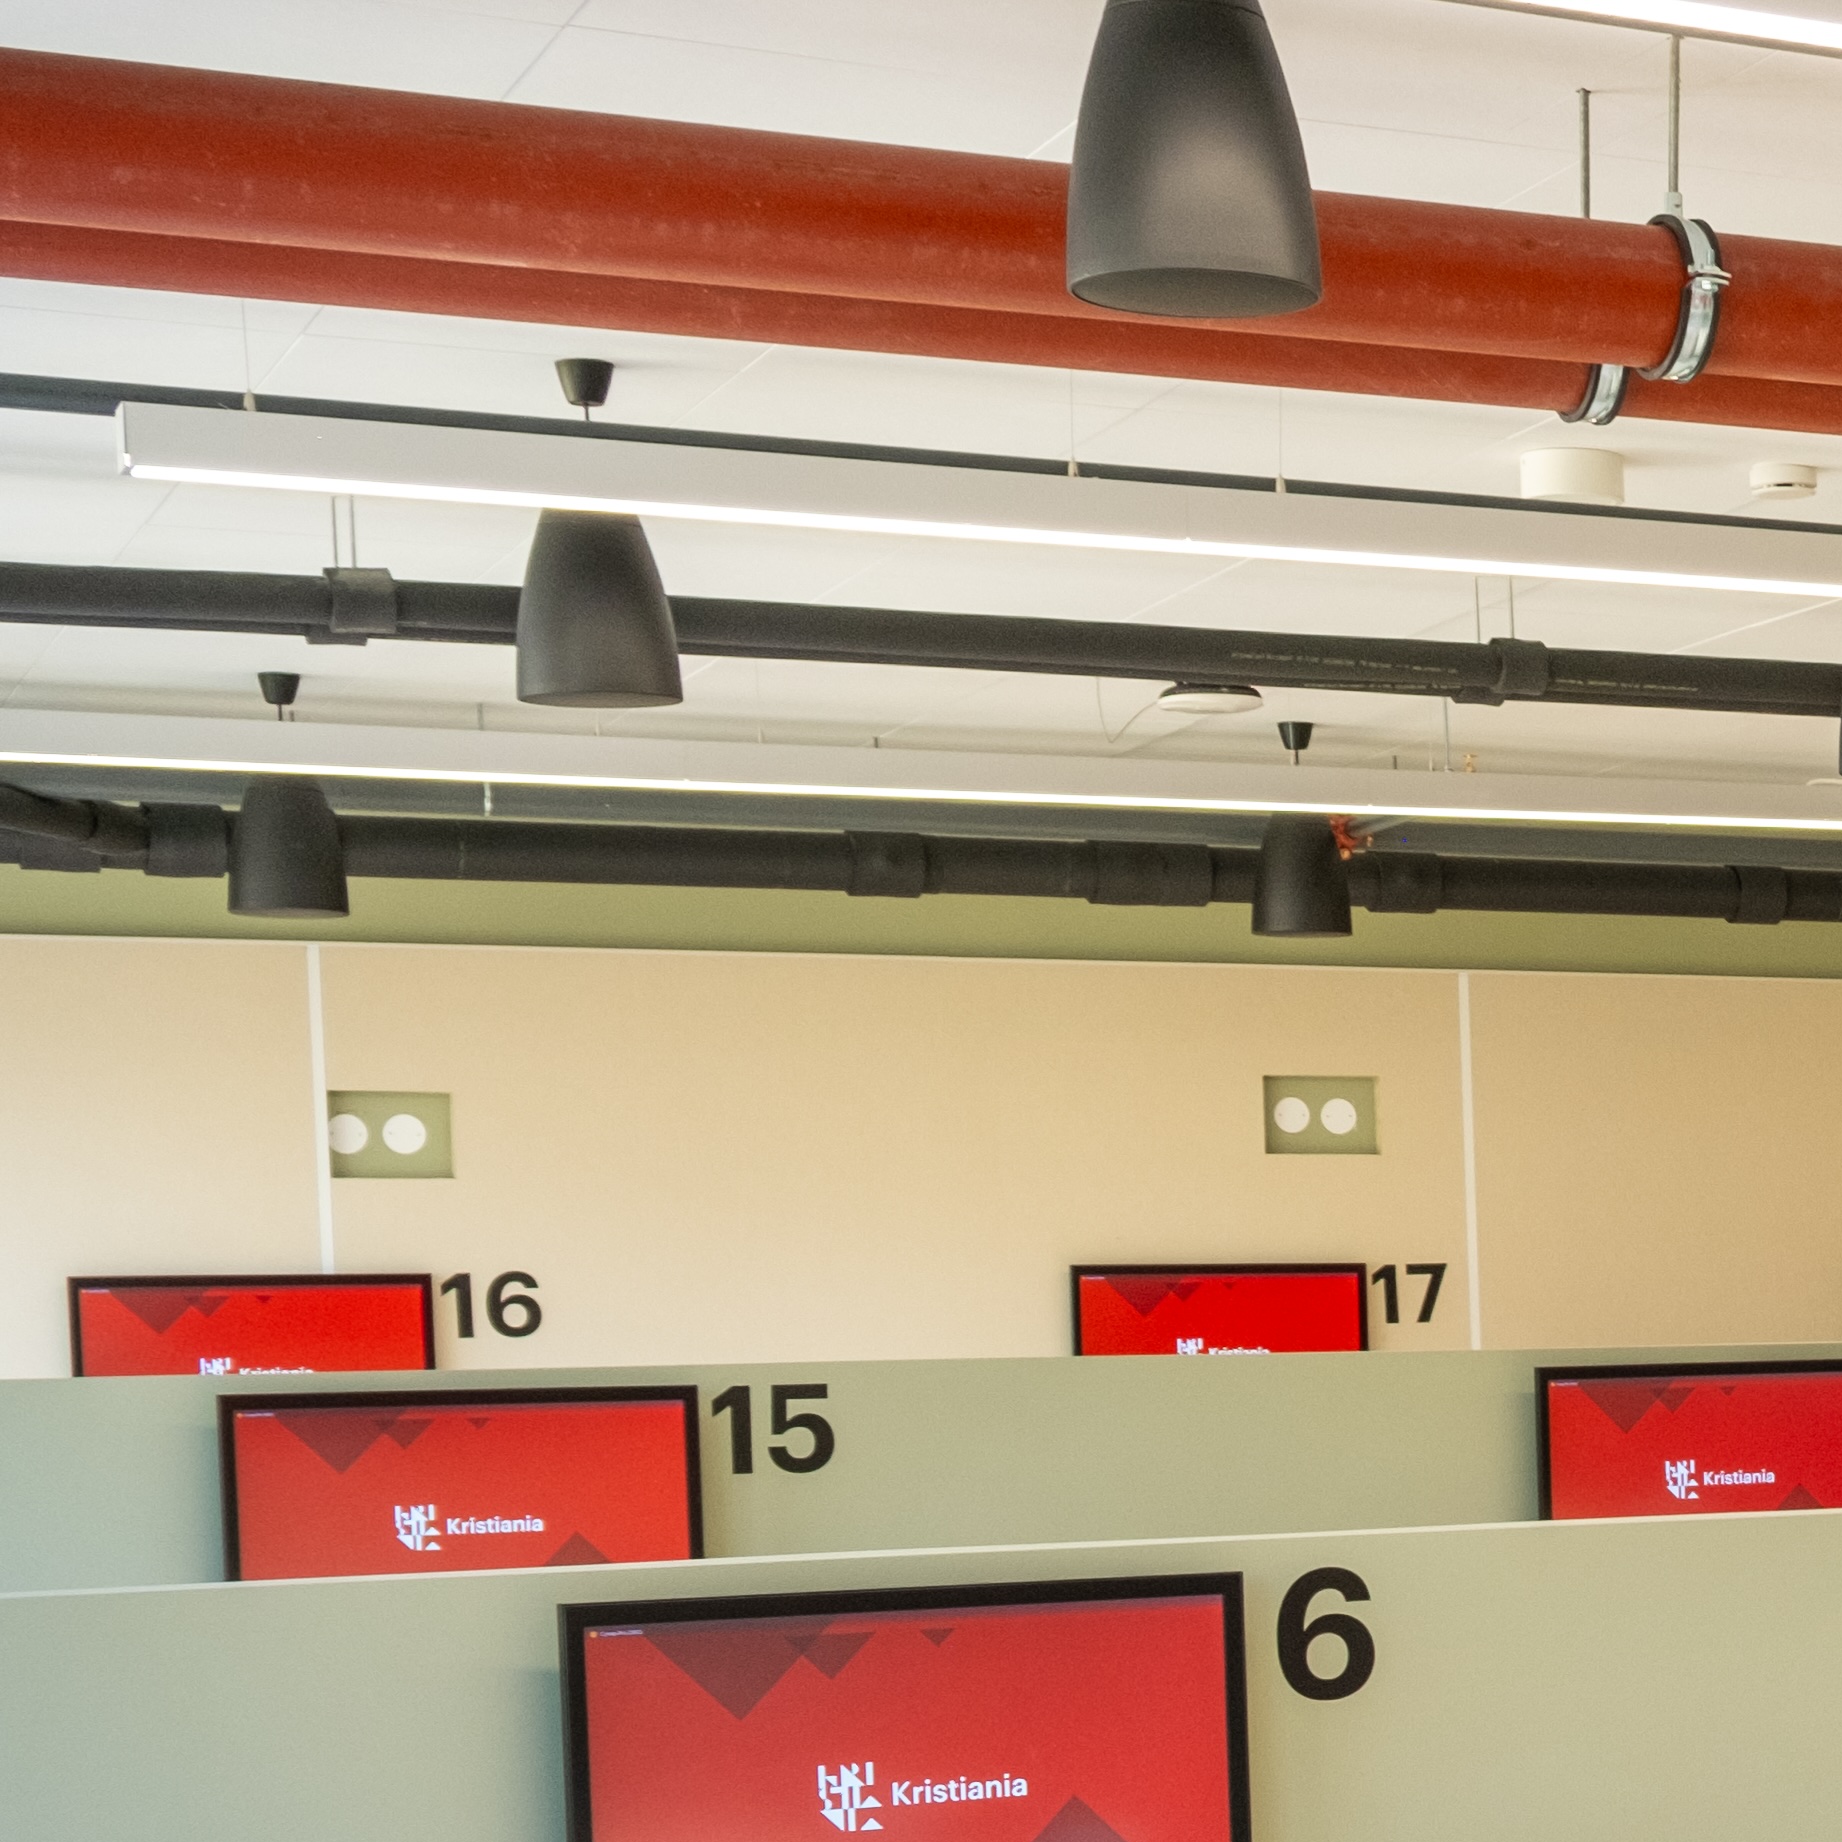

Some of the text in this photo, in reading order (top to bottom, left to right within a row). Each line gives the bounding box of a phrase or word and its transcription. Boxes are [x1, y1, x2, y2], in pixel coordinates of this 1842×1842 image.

[440, 1271, 542, 1339] 16
[1371, 1263, 1447, 1324] 17
[711, 1383, 836, 1475] 15
[1703, 1468, 1776, 1486] Kristiania
[446, 1514, 545, 1535] Kristiania
[1276, 1566, 1375, 1701] 6
[891, 1772, 1029, 1807] Kristiania
